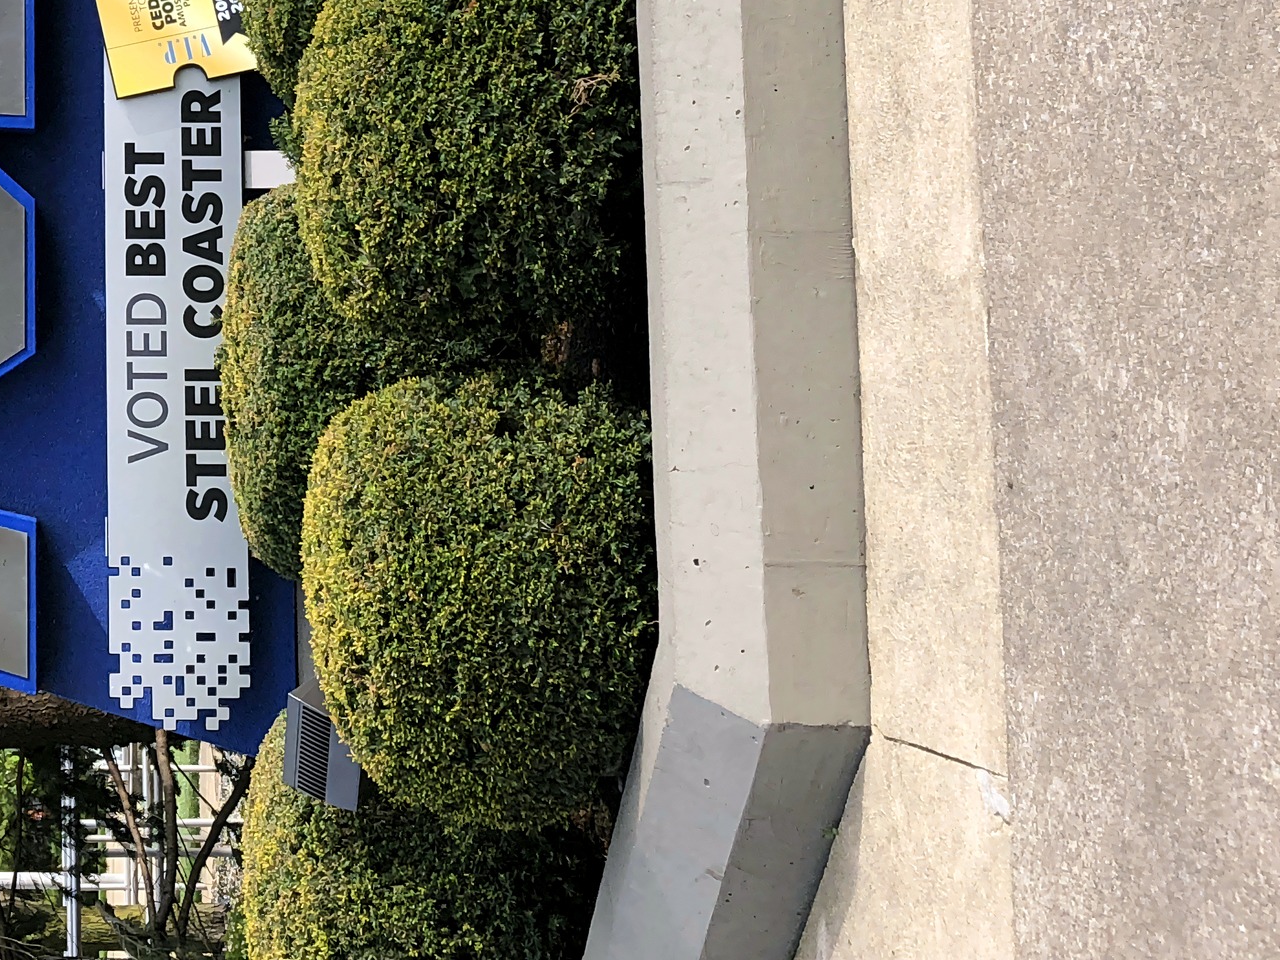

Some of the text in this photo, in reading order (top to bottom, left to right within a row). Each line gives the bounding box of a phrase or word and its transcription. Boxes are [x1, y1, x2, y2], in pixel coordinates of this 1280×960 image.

[124, 142, 169, 464] VOTED BEST
[181, 89, 224, 339] COASTER
